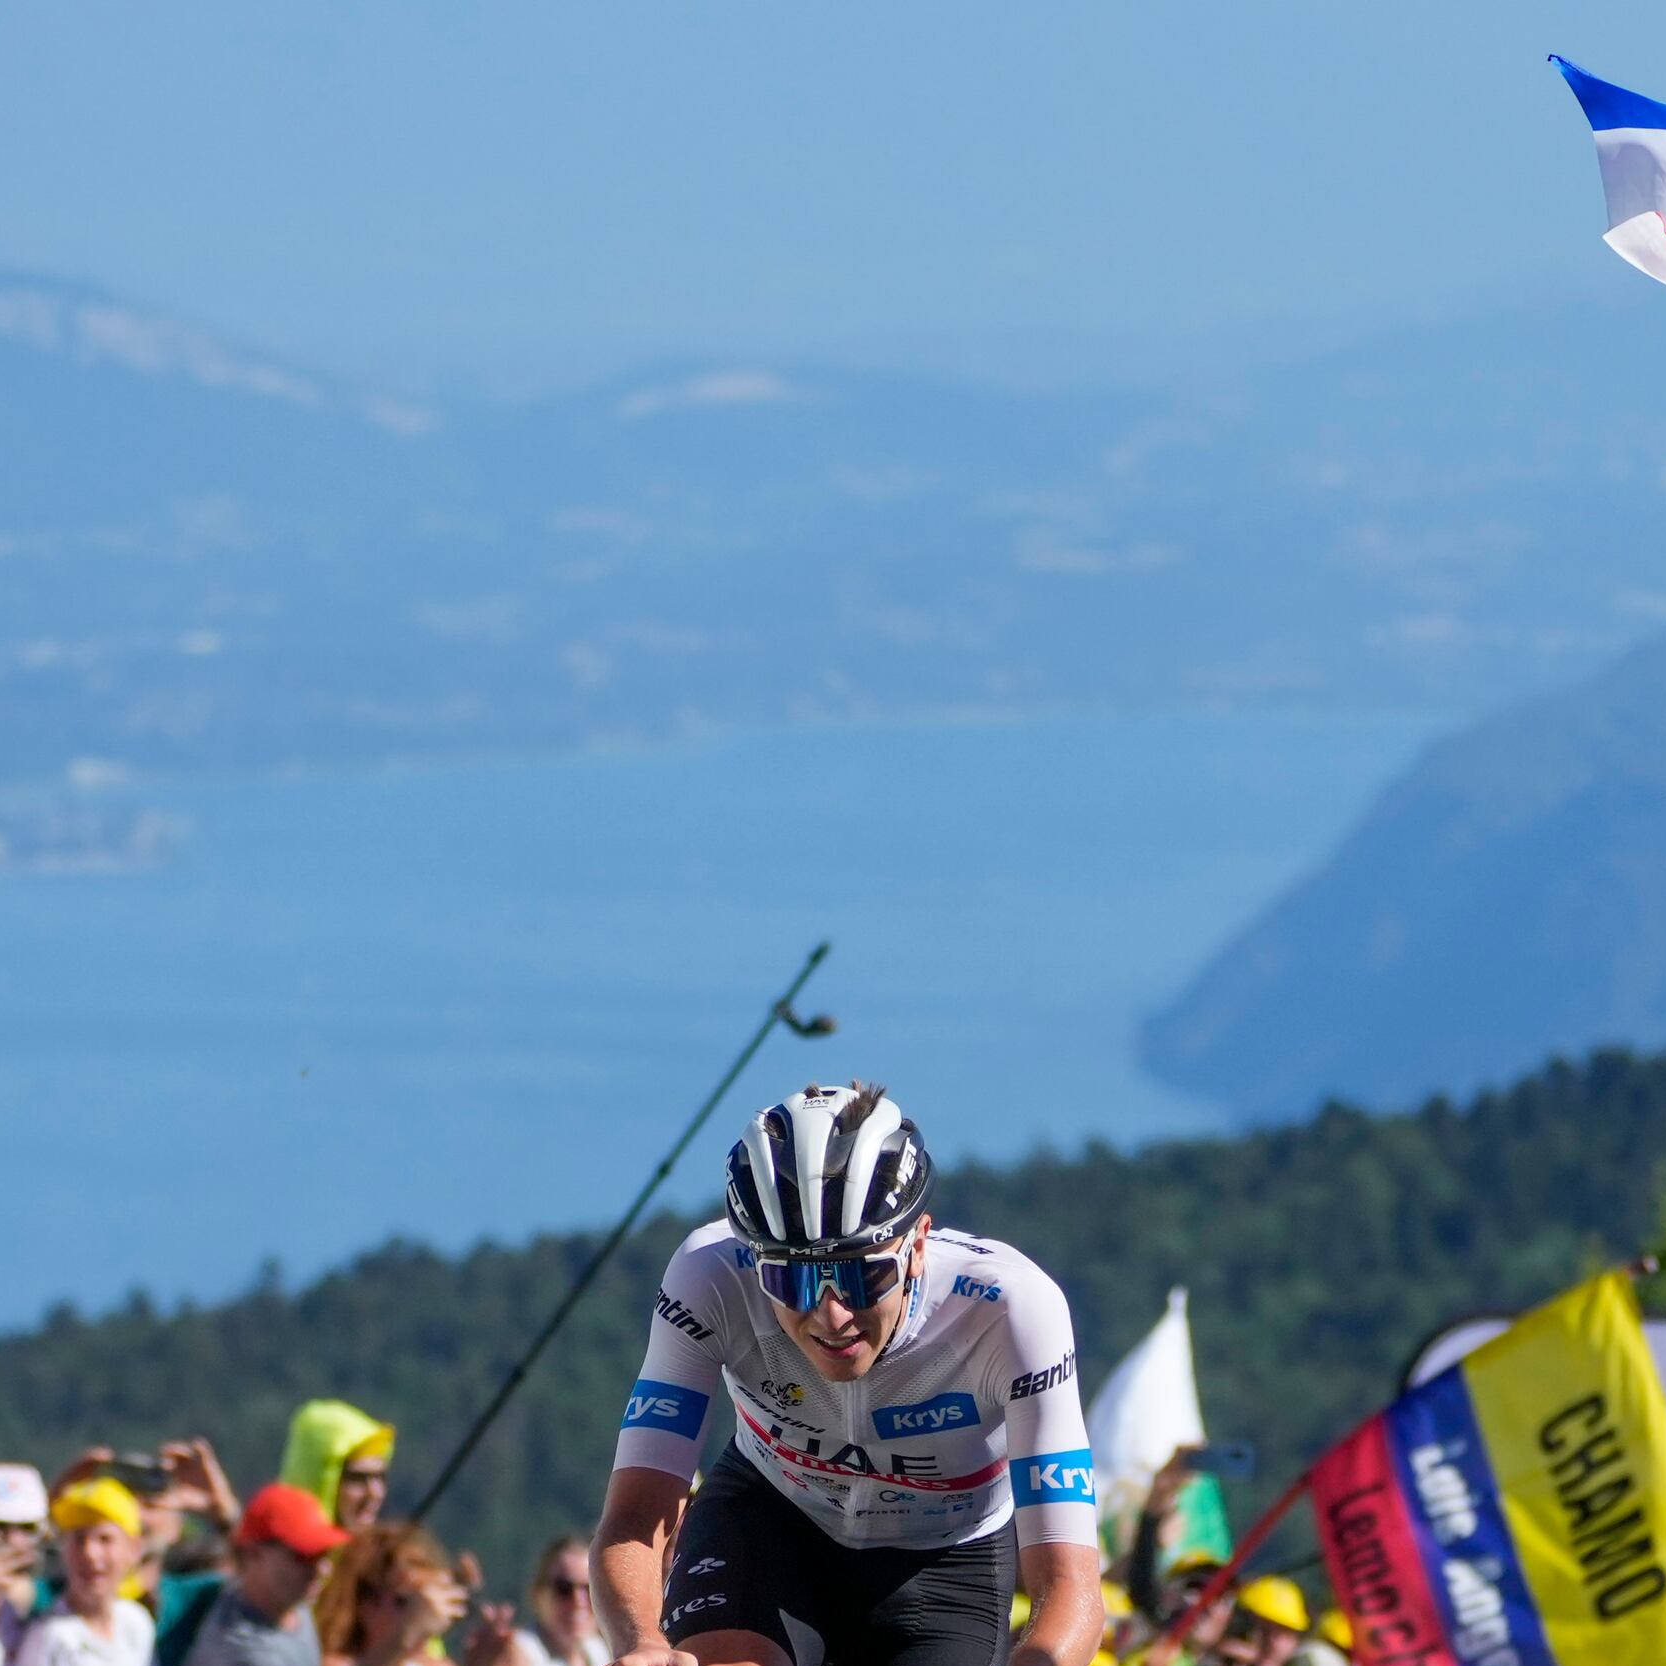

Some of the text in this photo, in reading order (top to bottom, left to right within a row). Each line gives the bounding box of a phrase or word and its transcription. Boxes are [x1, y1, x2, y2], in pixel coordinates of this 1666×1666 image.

[789, 1242, 839, 1257] MET
[872, 1226, 894, 1244] G42
[952, 1274, 1002, 1303] Krys
[736, 1384, 826, 1434] Santini
[892, 1403, 965, 1431] Krys
[769, 1423, 942, 1476] UAE
[1029, 1462, 1095, 1498] Kry
